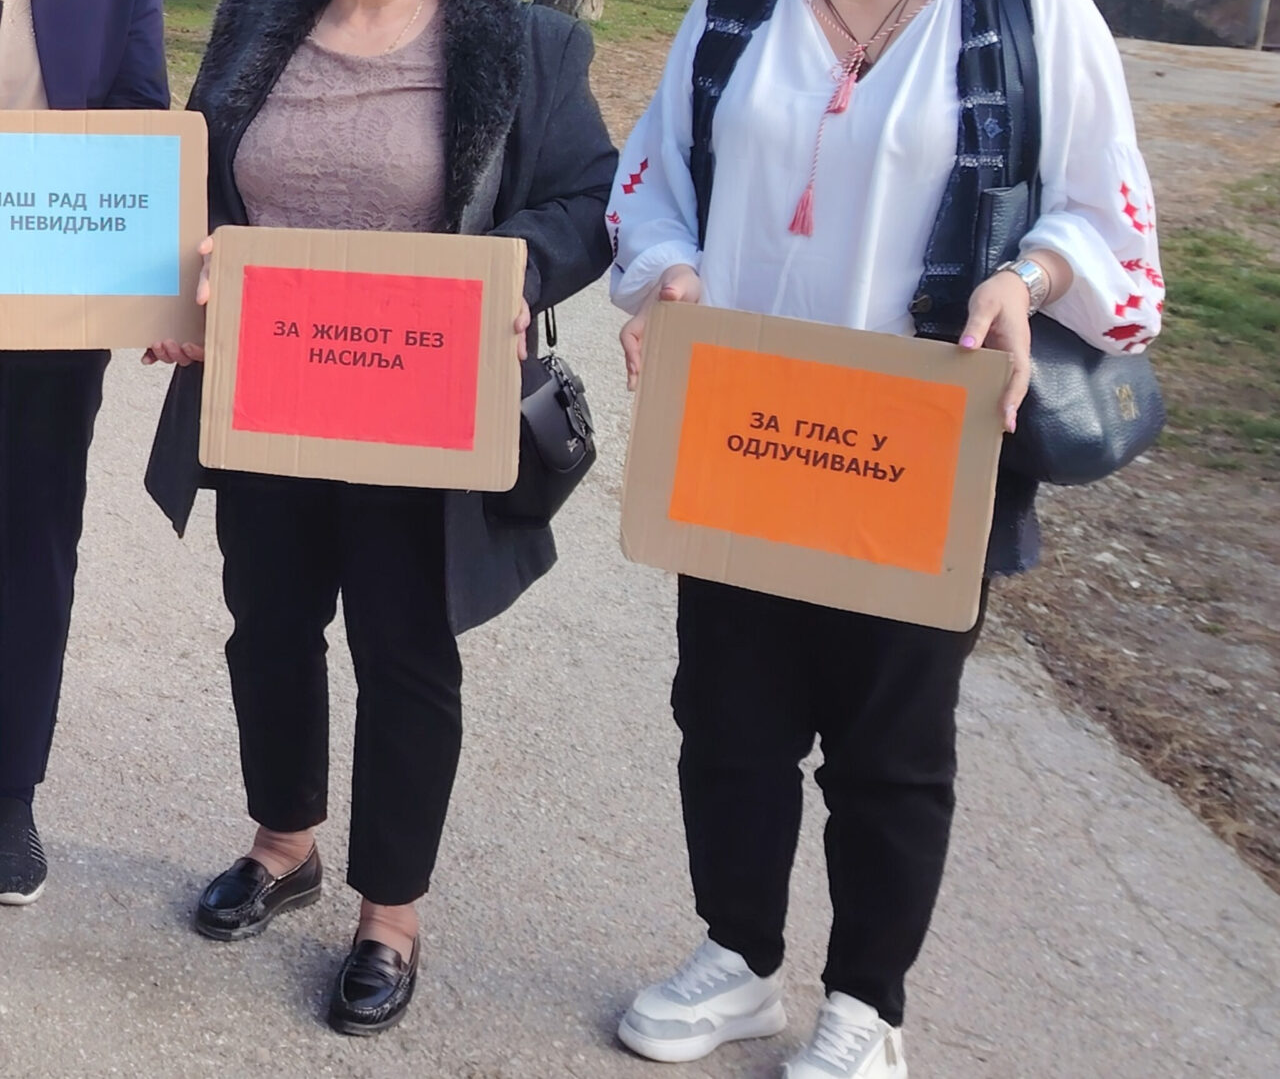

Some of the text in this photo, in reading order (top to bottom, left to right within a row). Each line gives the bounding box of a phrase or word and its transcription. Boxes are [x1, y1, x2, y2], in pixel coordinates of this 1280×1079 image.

[48, 192, 87, 211] РАД
[99, 193, 149, 209] НИЈЕ
[10, 215, 127, 234] НЕВИДЉИВ
[273, 321, 445, 348] ЗА ЖИВОТ БЕЗ
[309, 348, 405, 370] НАСИЉА
[749, 411, 888, 451] ЗА ГЛАС У
[727, 434, 906, 483] ОДЛУЧИВАЊУ
